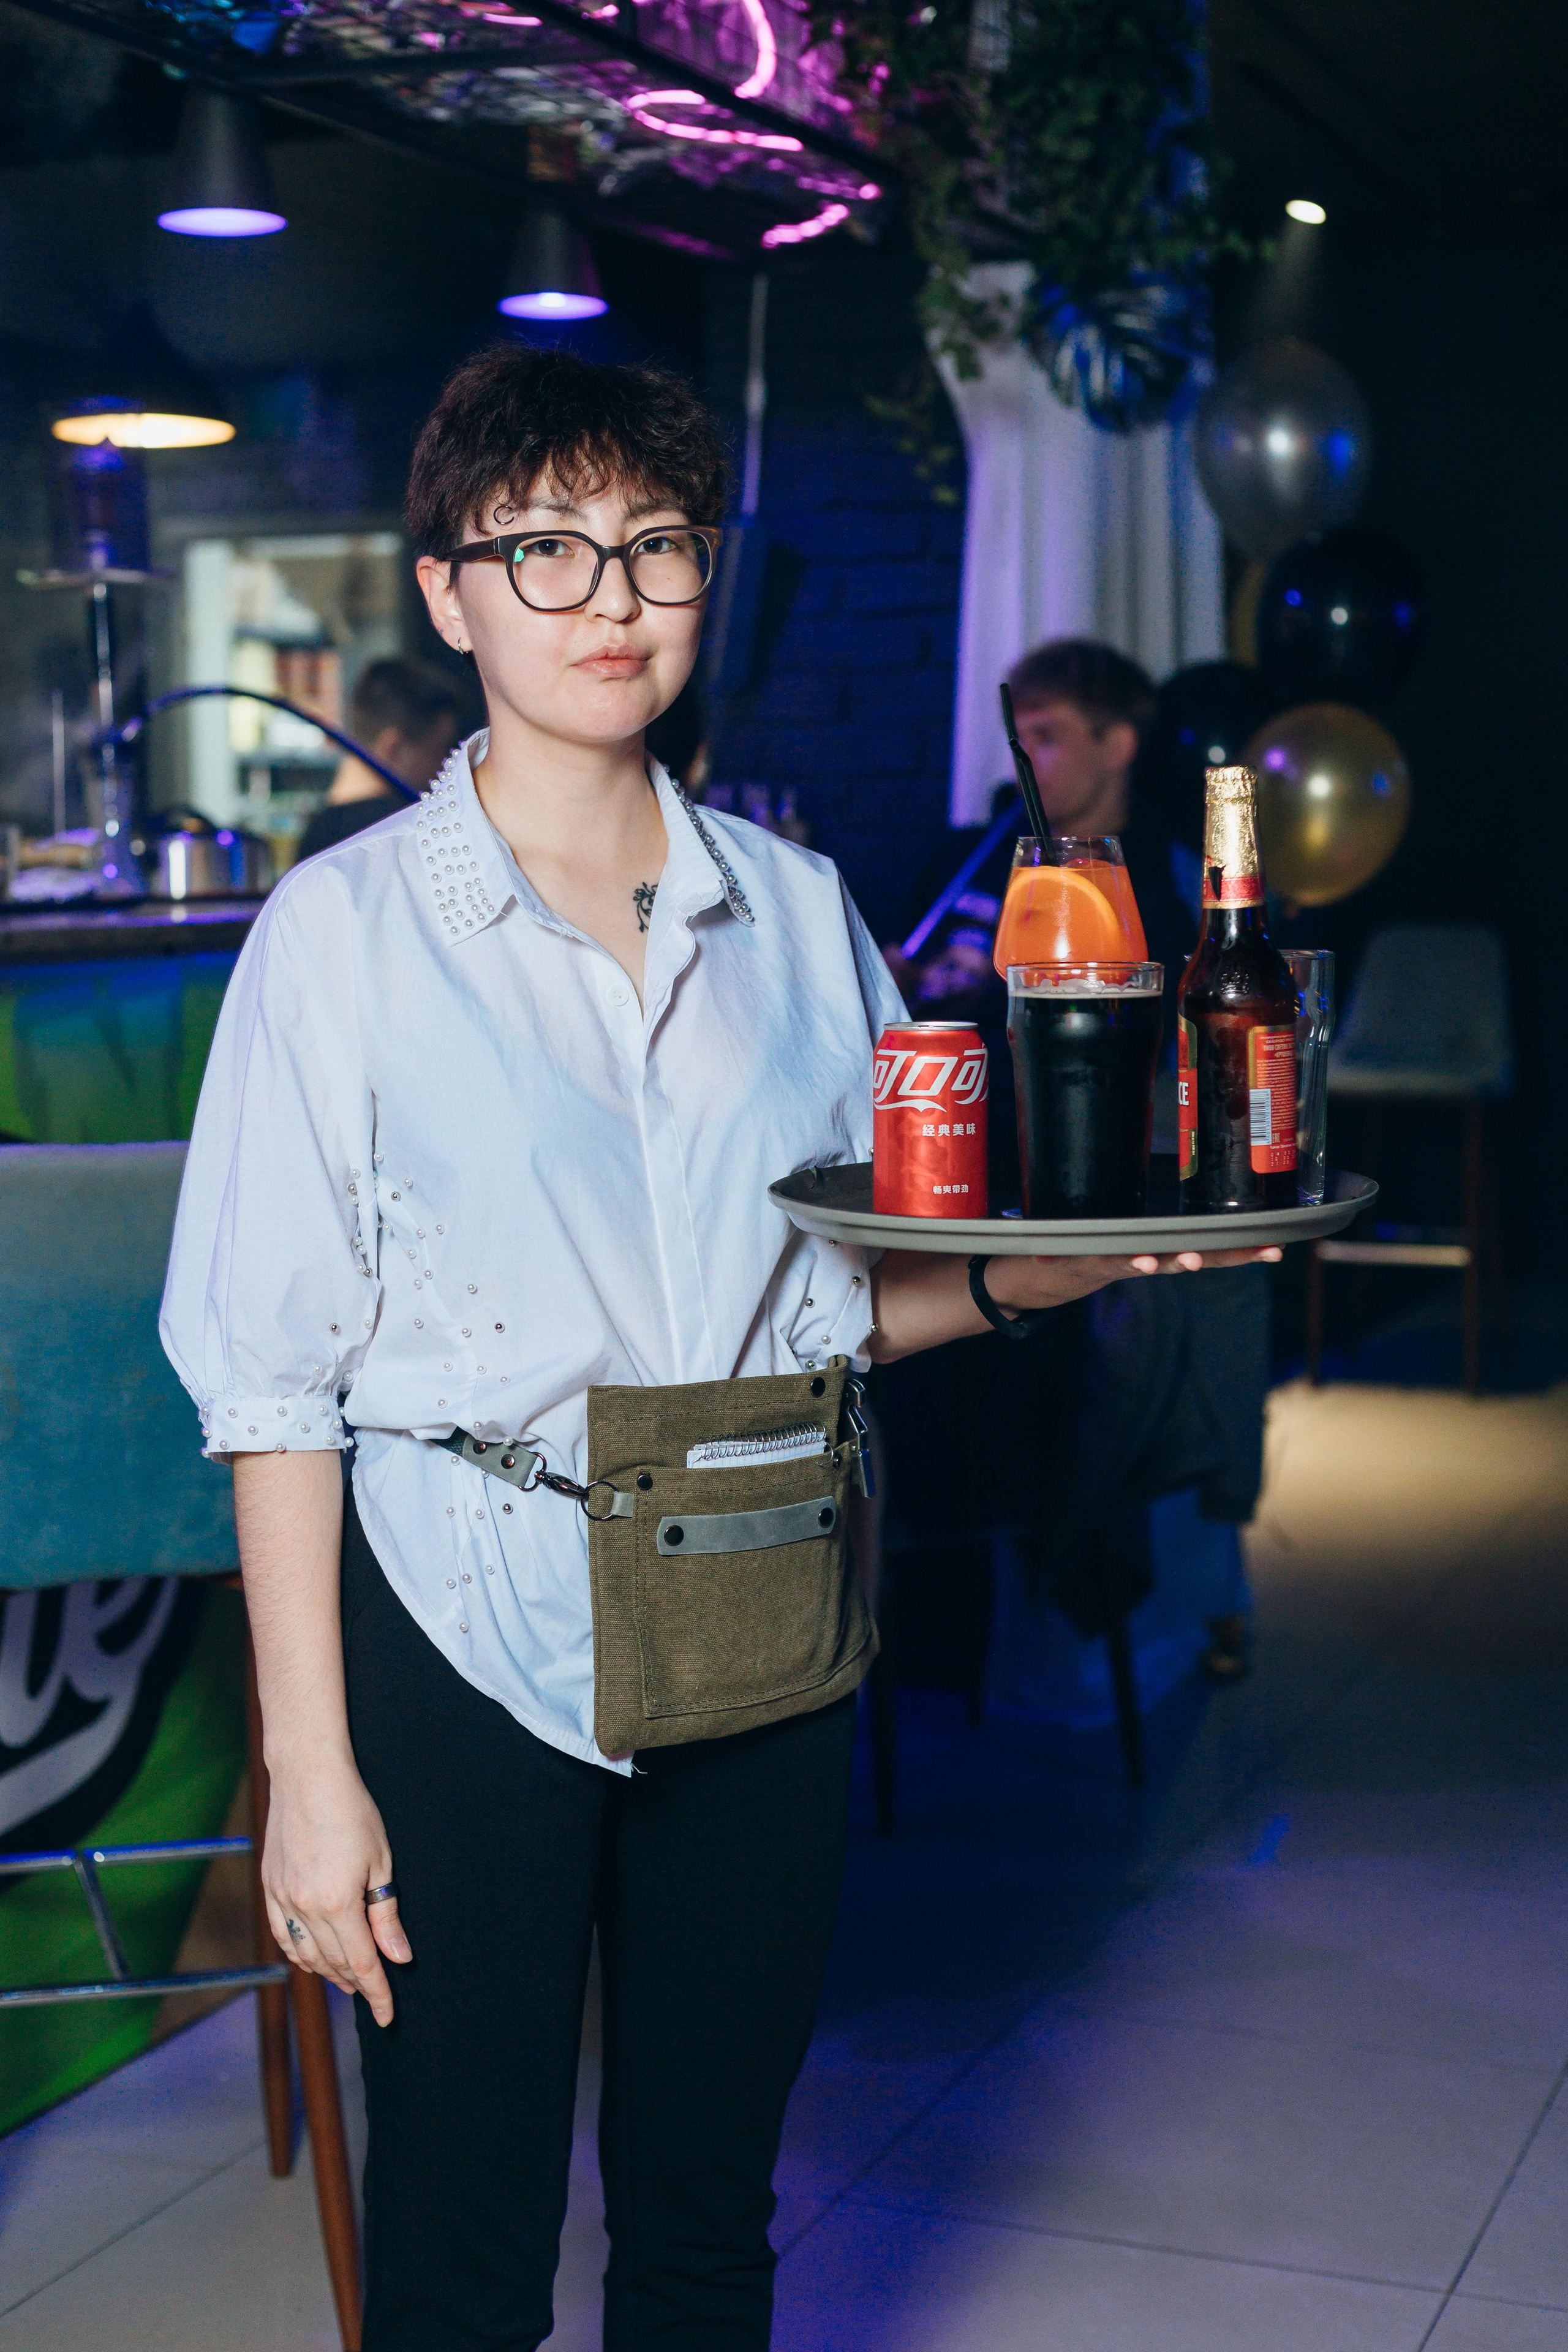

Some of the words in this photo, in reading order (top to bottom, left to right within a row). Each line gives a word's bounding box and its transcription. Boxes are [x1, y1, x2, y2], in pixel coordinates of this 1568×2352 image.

[873, 1043, 989, 1105] 可口可
[922, 1123, 976, 1137] 经典美味
[933, 1184, 969, 1194] 畅爽带劲
